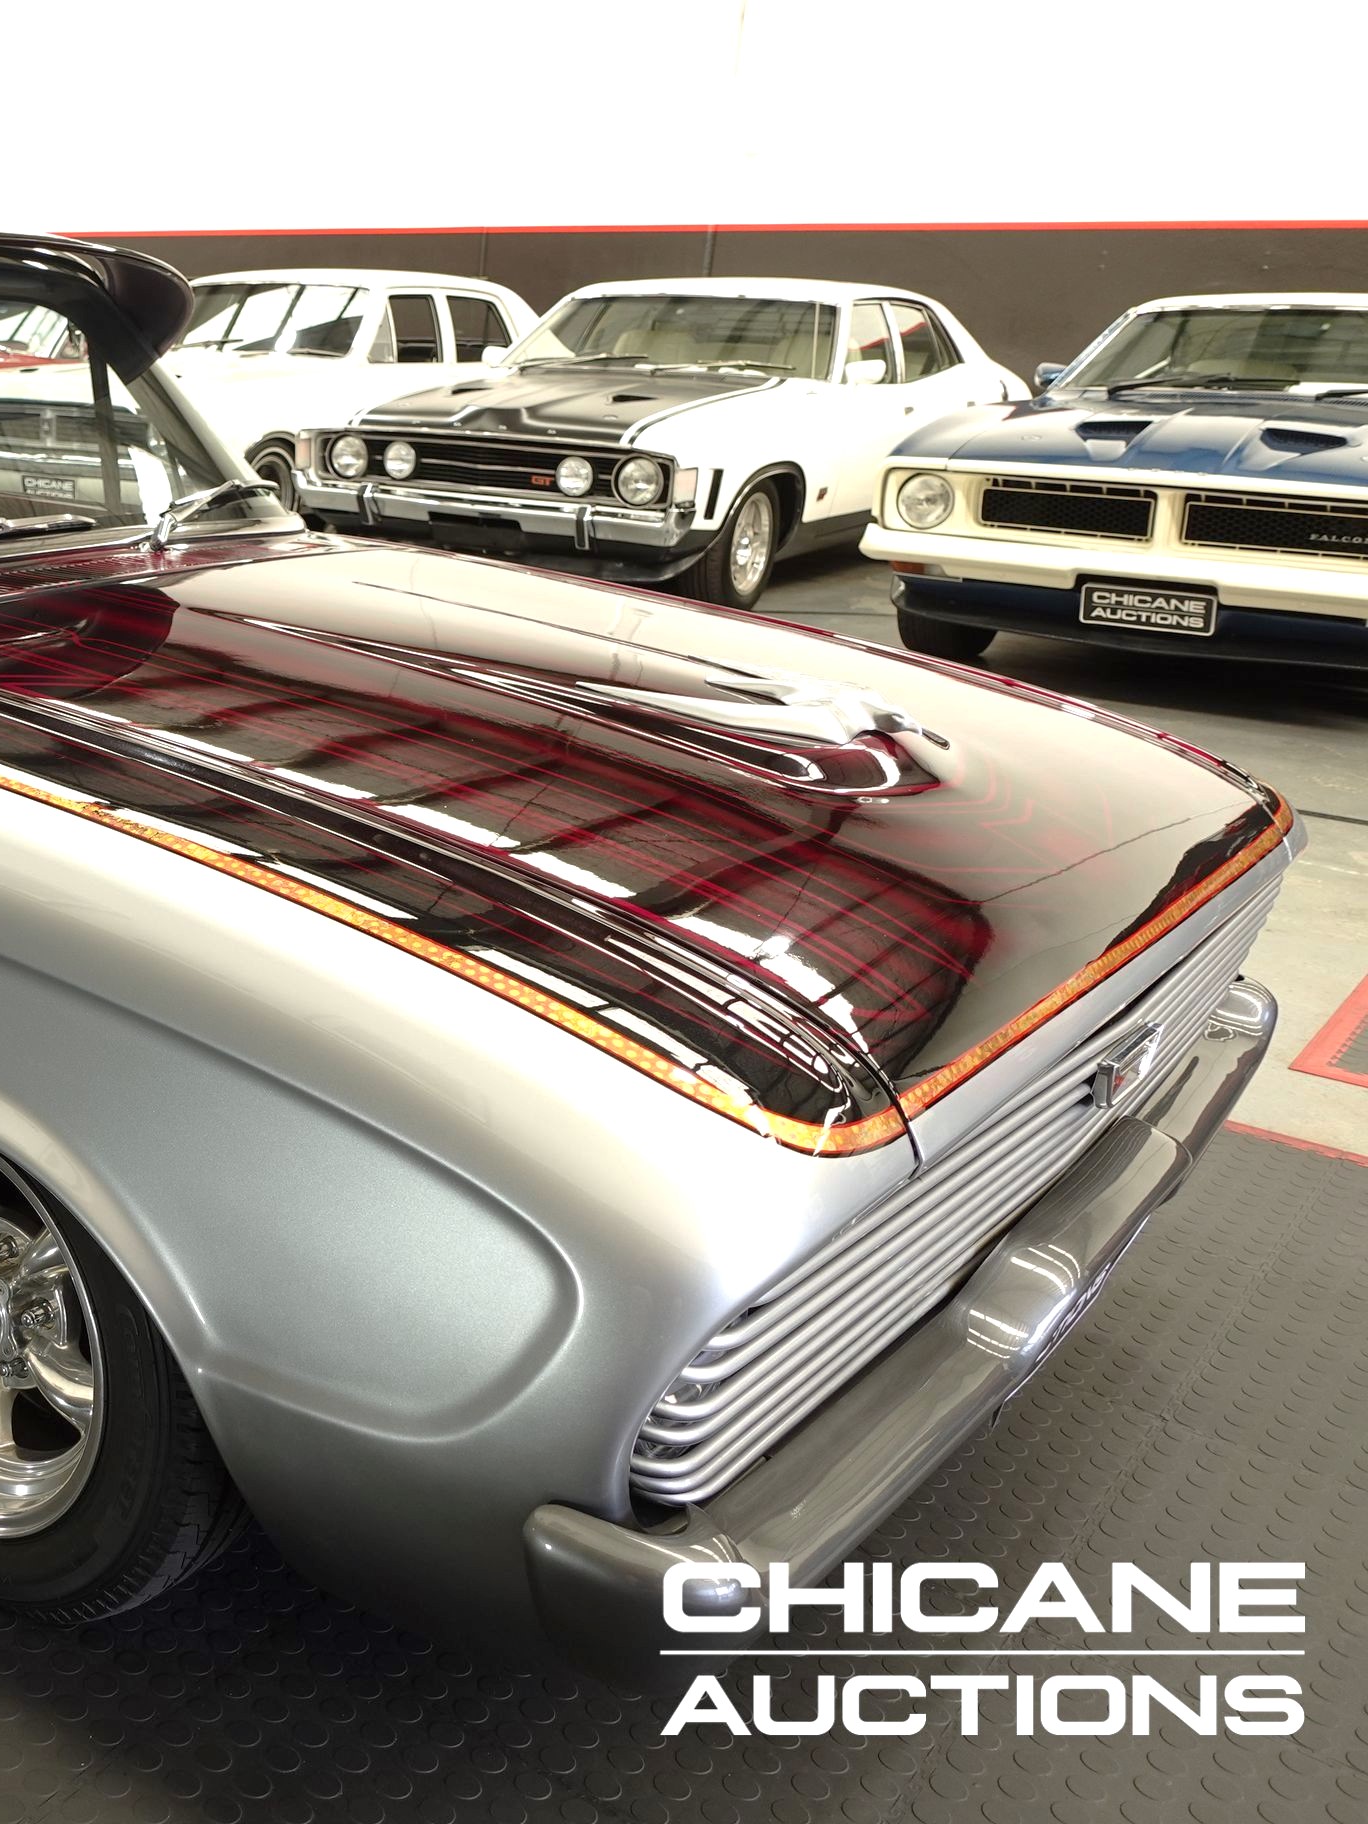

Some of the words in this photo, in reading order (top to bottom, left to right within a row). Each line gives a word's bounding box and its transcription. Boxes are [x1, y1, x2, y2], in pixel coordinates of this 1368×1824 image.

[24, 477, 73, 491] CHICANE
[532, 475, 553, 486] GT
[1092, 591, 1207, 614] CHICANE
[1090, 606, 1204, 628] AUCTIONS
